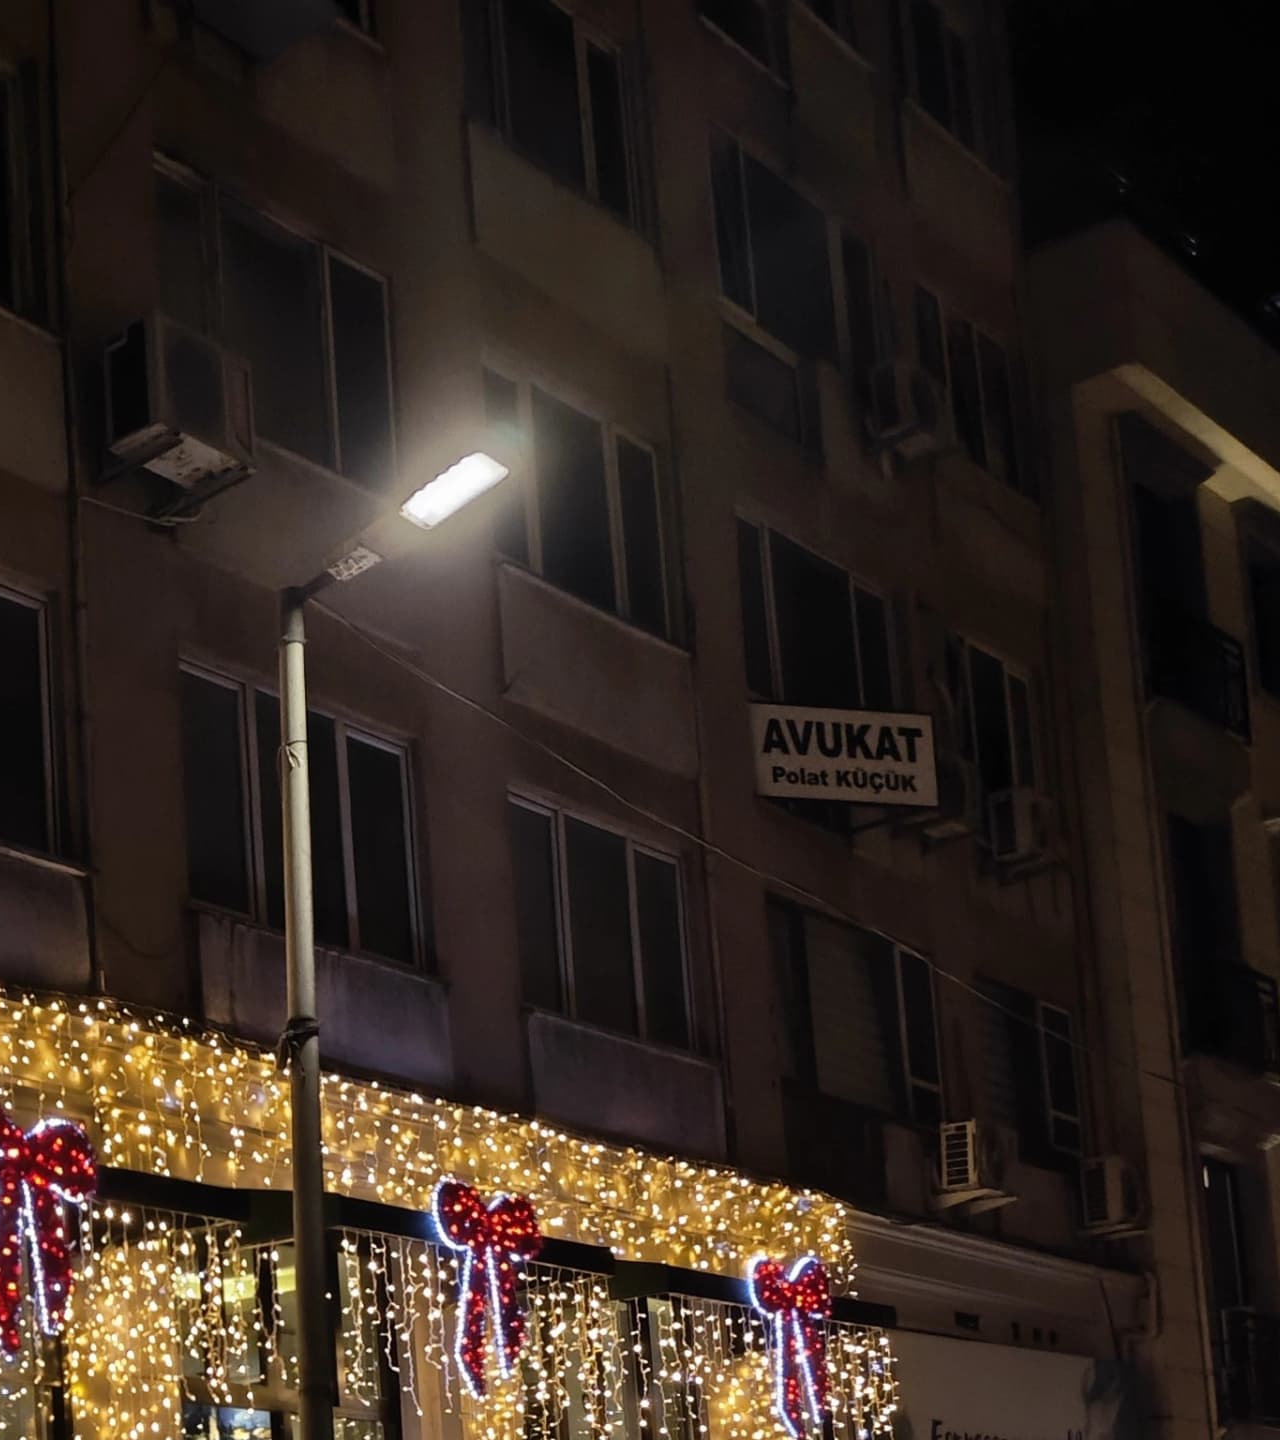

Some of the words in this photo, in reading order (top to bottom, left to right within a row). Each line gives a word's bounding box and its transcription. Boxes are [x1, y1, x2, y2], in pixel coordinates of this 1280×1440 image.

[762, 718, 923, 763] AVUKAT
[772, 766, 829, 787] Polat
[836, 767, 917, 794] KÜÇÜK
